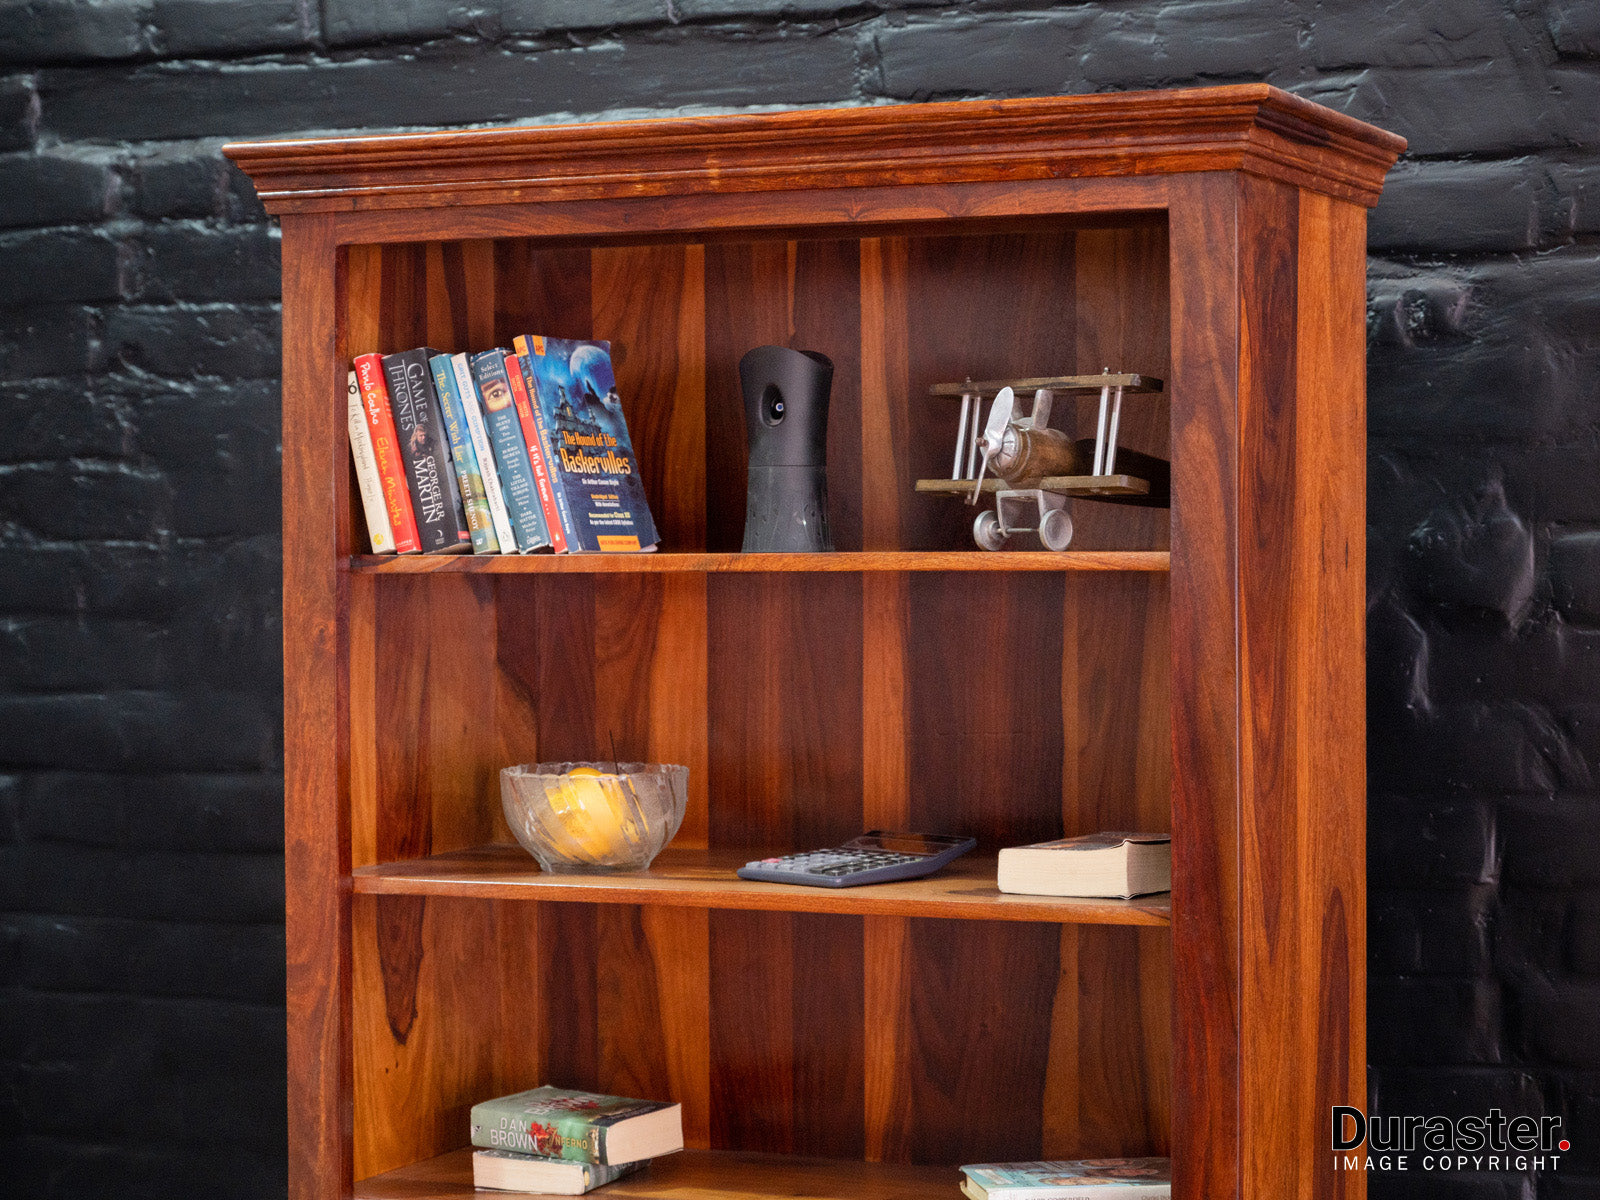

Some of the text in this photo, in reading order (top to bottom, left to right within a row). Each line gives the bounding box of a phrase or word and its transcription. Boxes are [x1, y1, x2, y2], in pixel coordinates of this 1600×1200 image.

[360, 362, 380, 424] Paulo Coelho
[388, 364, 414, 431] THRONES
[408, 363, 428, 410] GAME
[437, 370, 447, 390] The
[442, 392, 453, 420] Secret
[450, 421, 461, 444] Wish
[540, 429, 558, 484] Baskervilles
[560, 448, 632, 474] Baskervilles
[562, 430, 618, 447] The Hound of the
[377, 437, 402, 526] Eleven Minutes
[413, 458, 440, 524] MARTIN
[427, 456, 442, 500] GEORGE
[490, 1130, 538, 1150] BROWN
[500, 1117, 527, 1132] DAN
